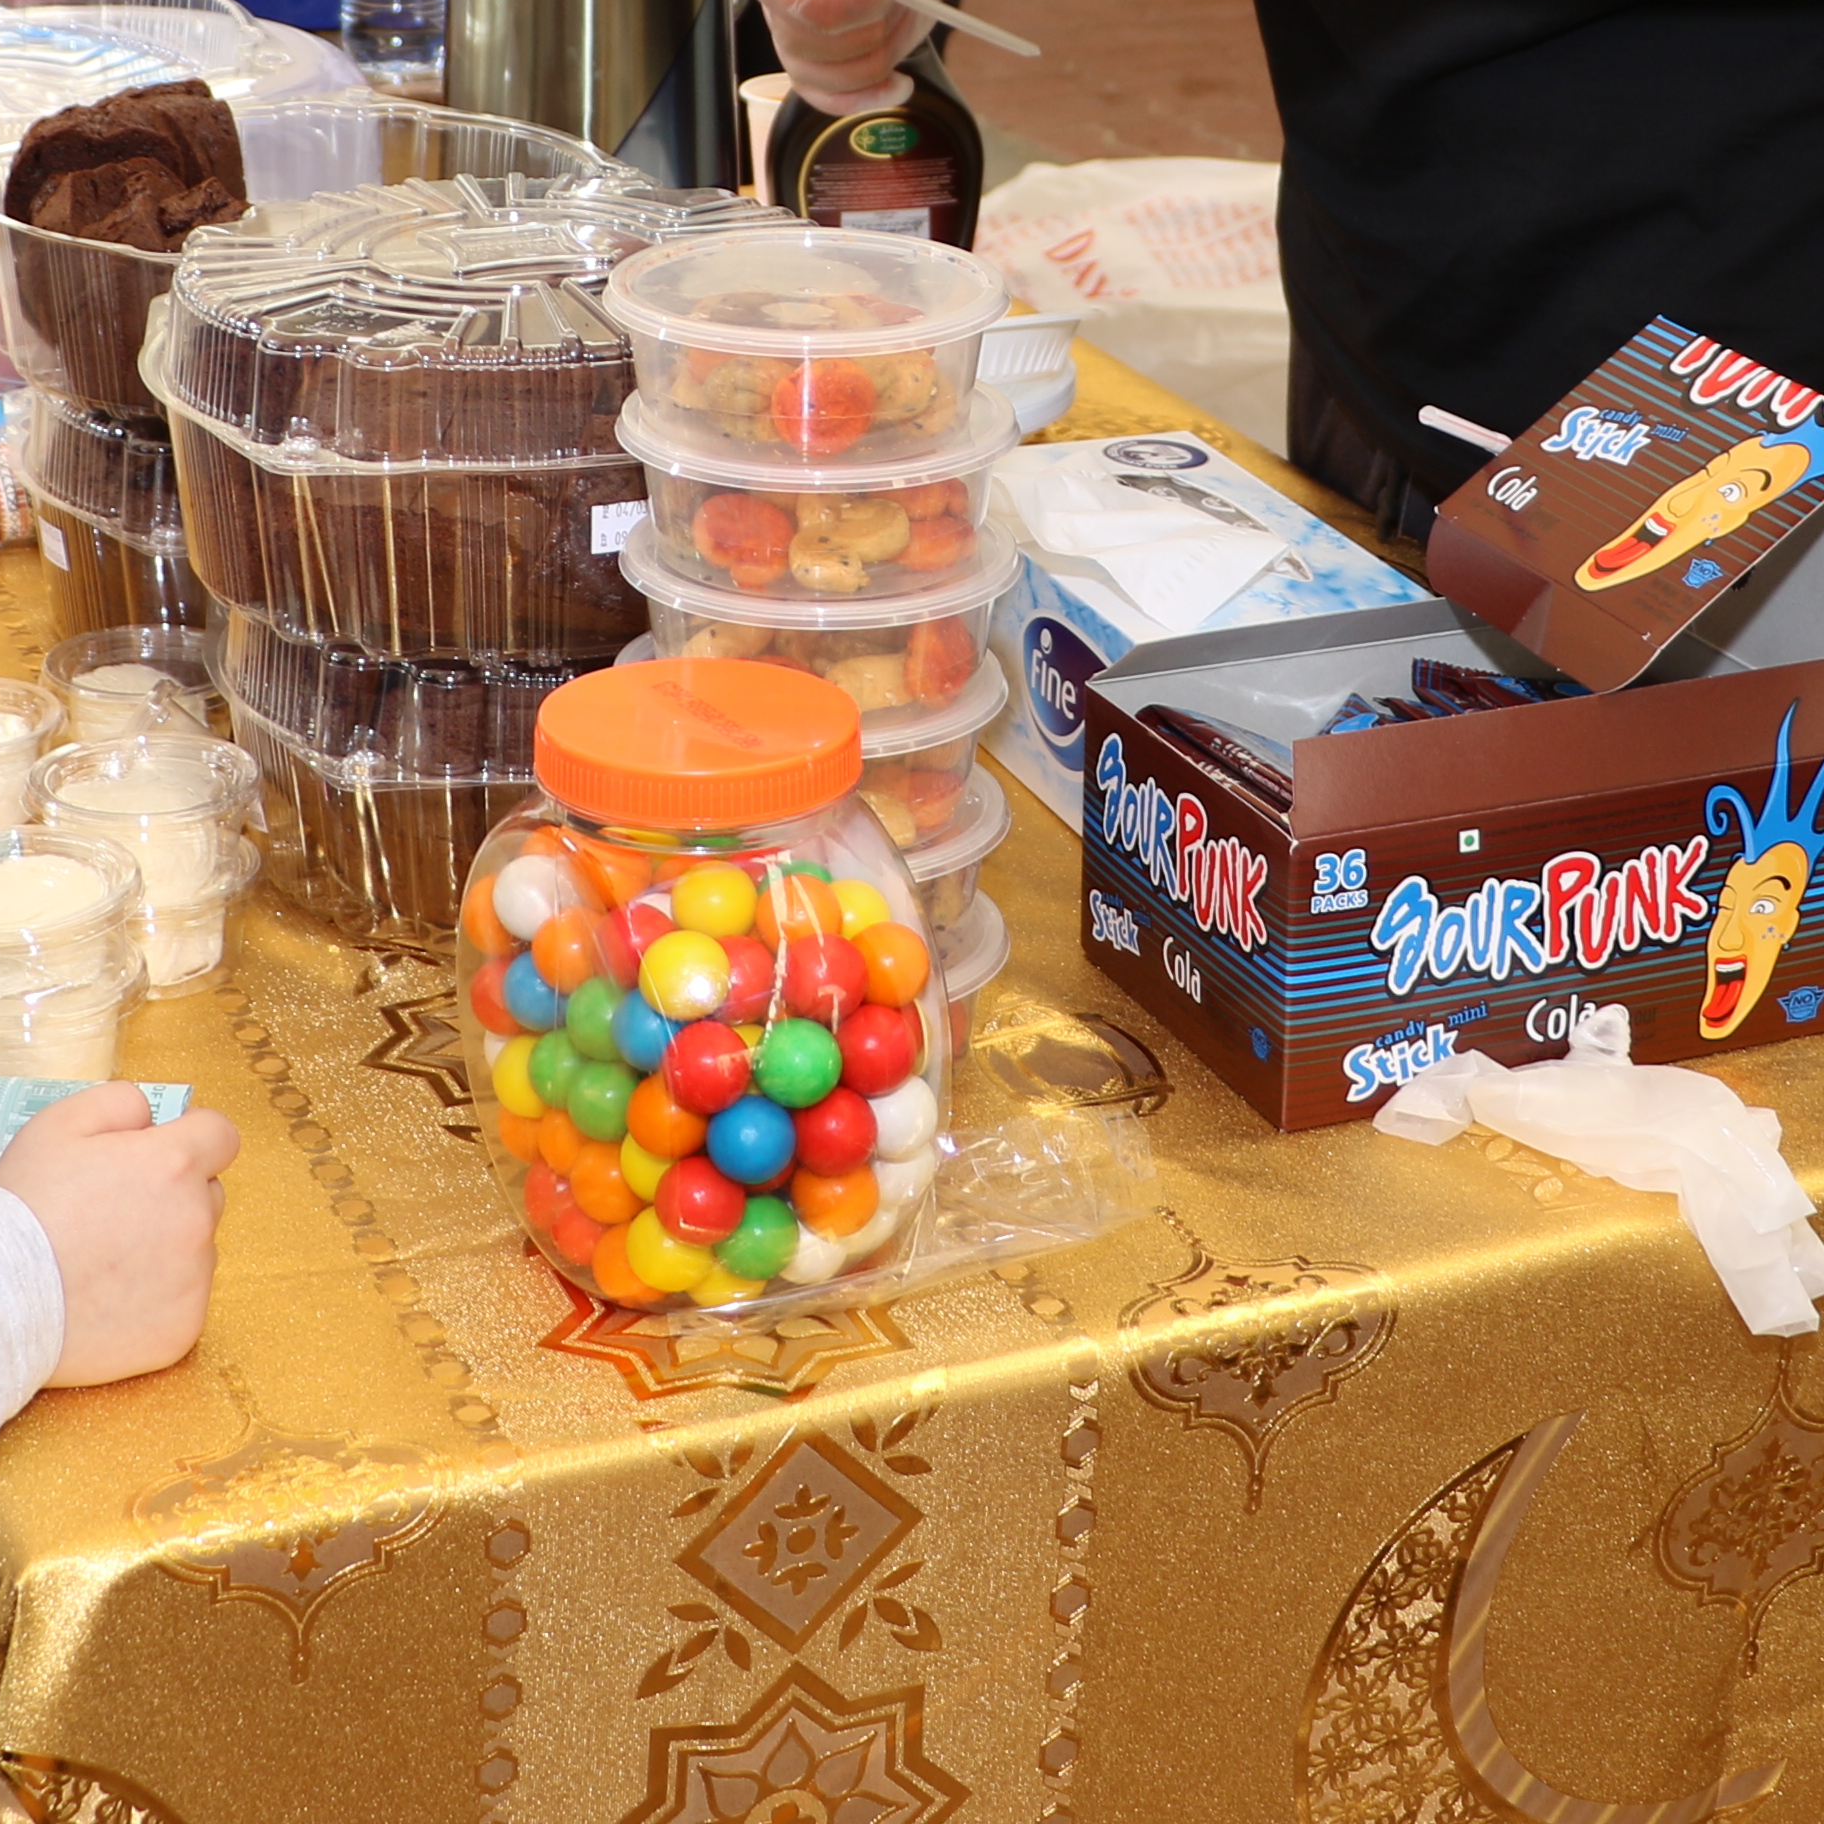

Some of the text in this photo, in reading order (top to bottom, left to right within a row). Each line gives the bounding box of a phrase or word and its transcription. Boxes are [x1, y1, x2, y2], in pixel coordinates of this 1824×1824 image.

[1540, 406, 1653, 466] Stick
[1599, 408, 1643, 427] candy
[1650, 423, 1689, 443] mini
[1487, 466, 1538, 511] Cola
[1030, 628, 1077, 721] Fine
[1314, 849, 1367, 894] 36
[1089, 889, 1140, 956] Stick
[1310, 889, 1370, 914] PACKS
[1163, 936, 1201, 1003] Cola
[1447, 1000, 1489, 1027] mini
[1792, 993, 1814, 1006] NO
[1375, 1020, 1427, 1048] candy
[1343, 1023, 1458, 1103] Stick
